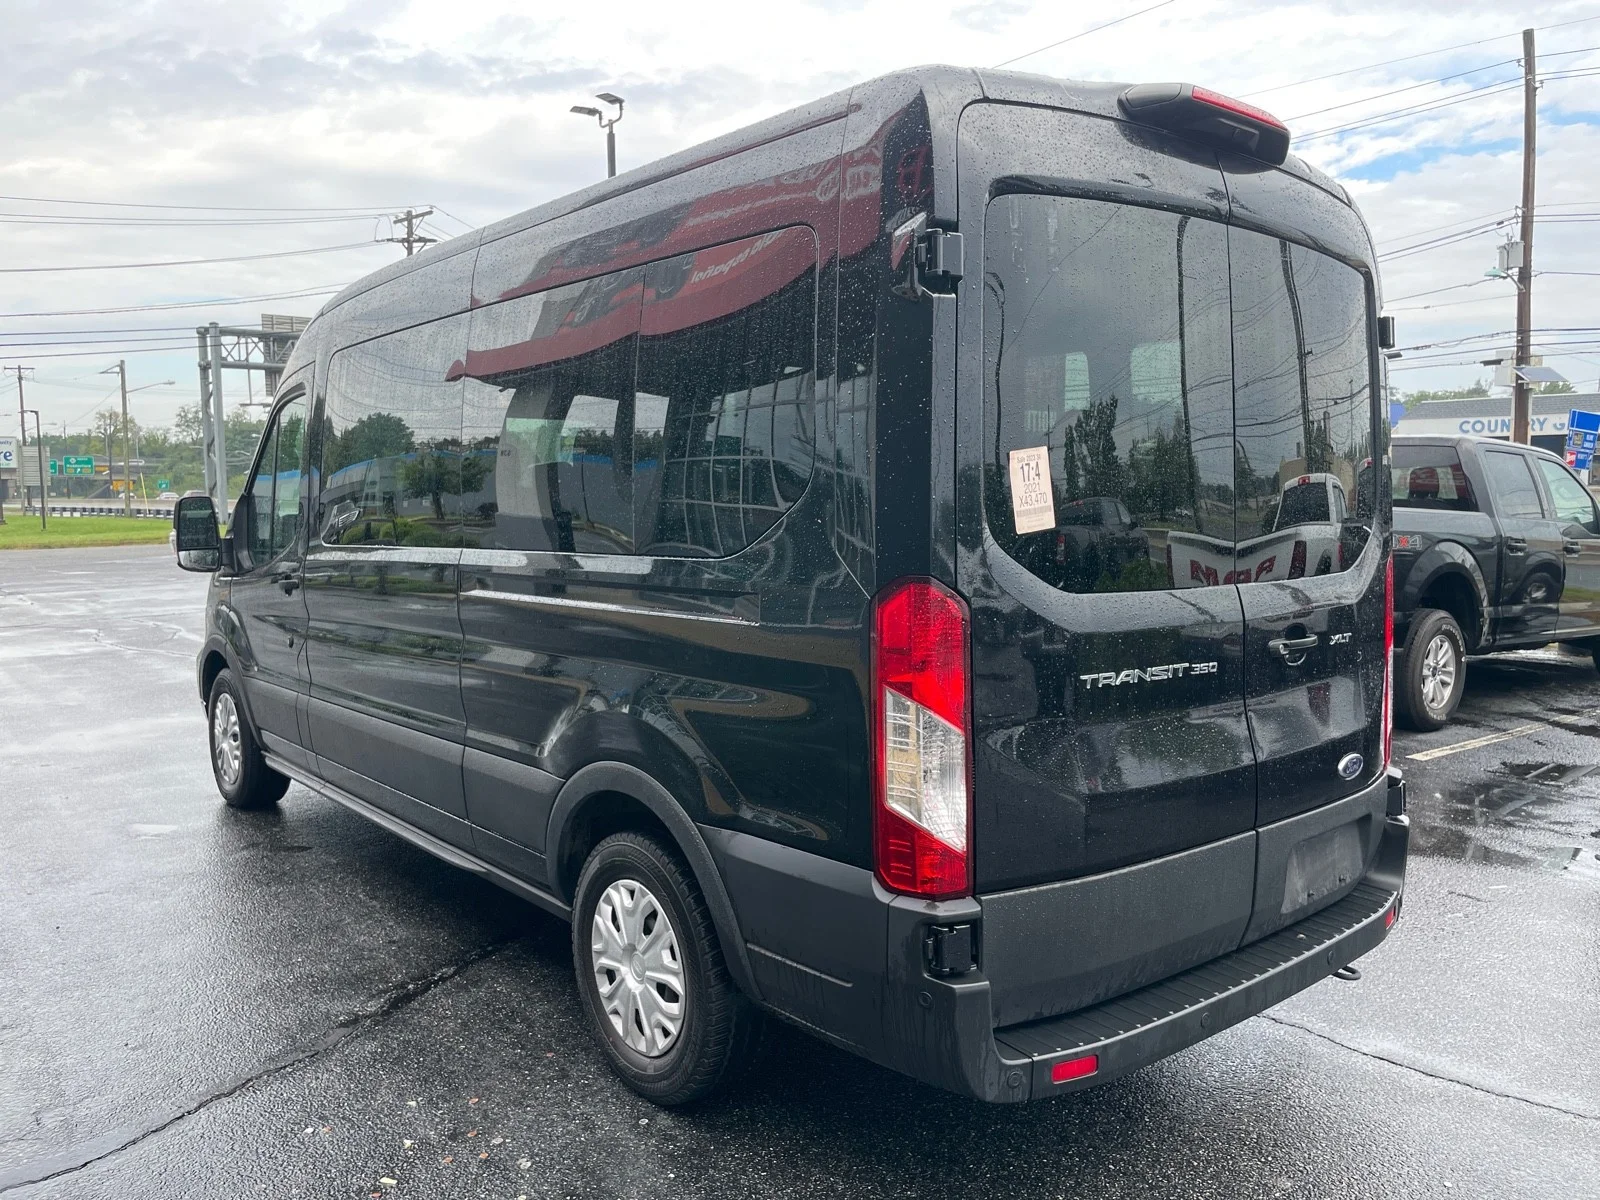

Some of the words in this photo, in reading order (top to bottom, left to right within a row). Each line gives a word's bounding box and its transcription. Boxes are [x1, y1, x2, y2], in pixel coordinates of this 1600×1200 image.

[1458, 417, 1548, 434] COUNRY
[1020, 461, 1041, 483] 17:4
[1023, 482, 1041, 495] 2021
[1329, 632, 1352, 645] XLT
[1080, 662, 1190, 690] TRANSIT
[1190, 661, 1218, 676] 350
